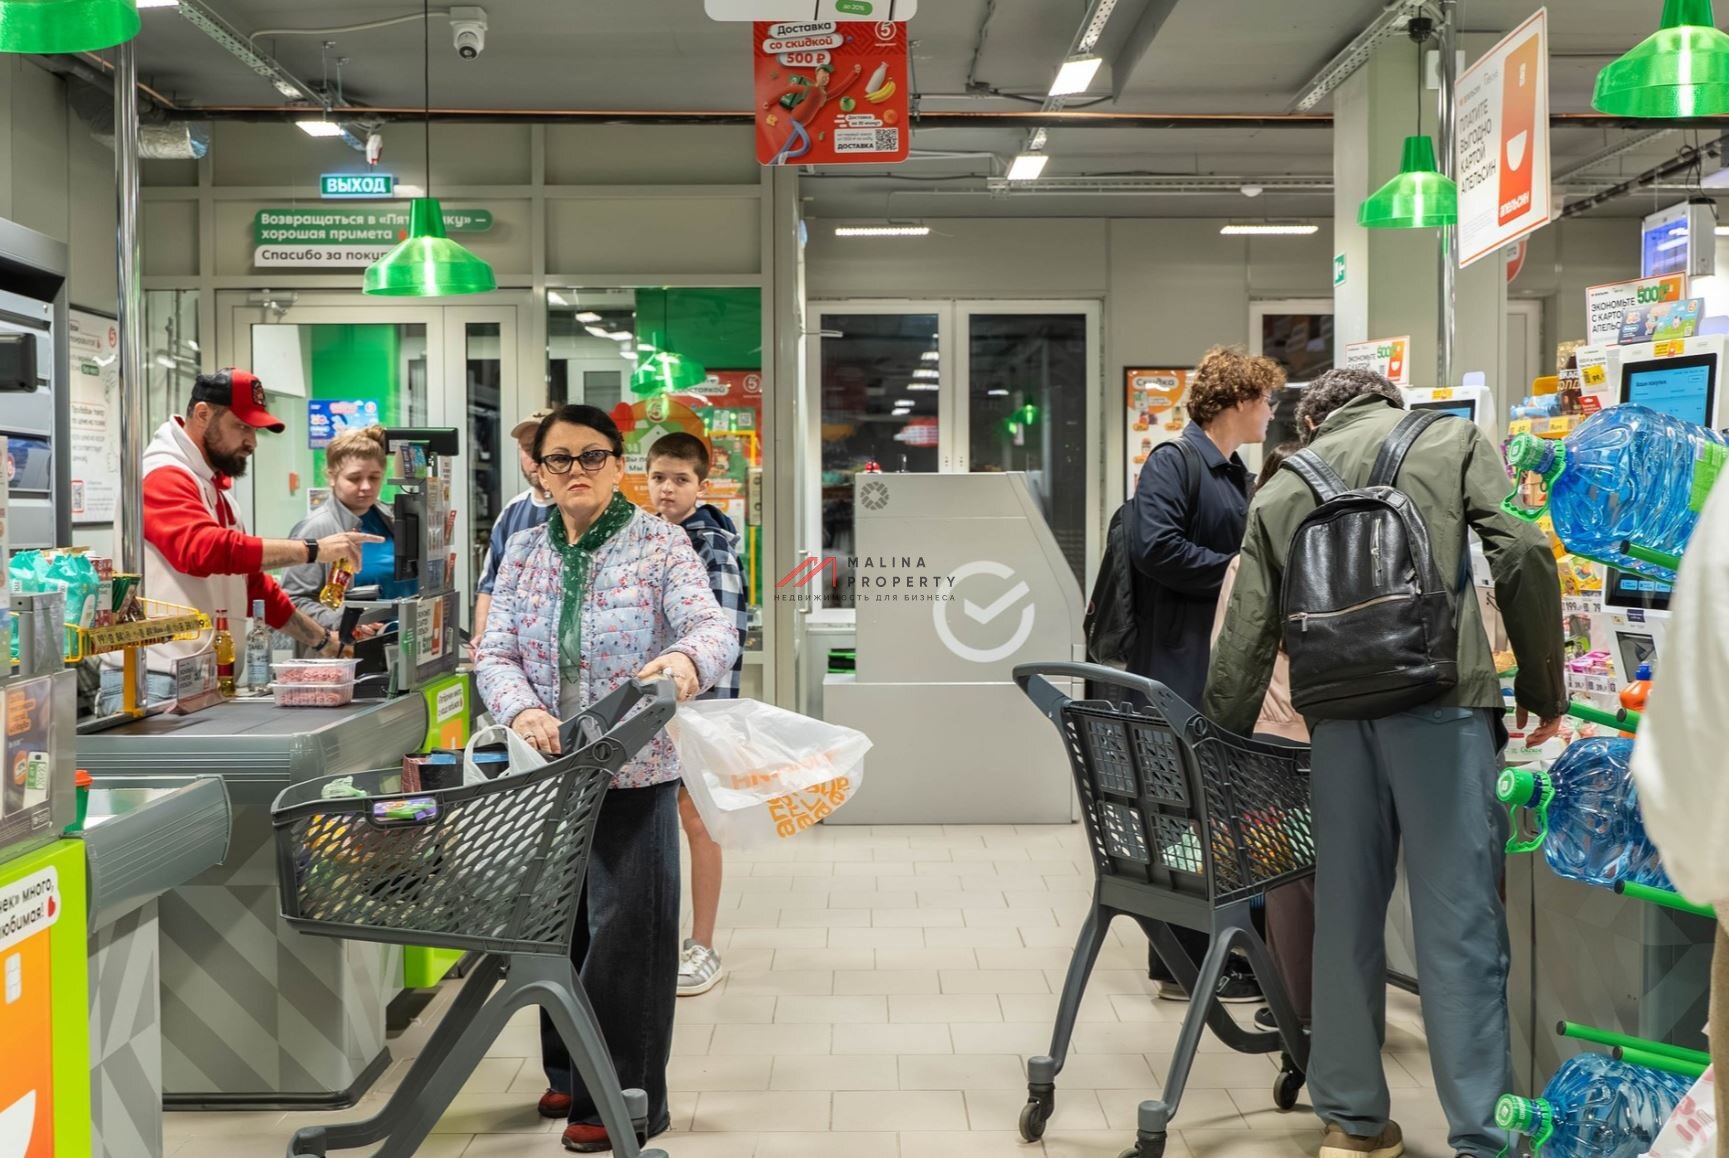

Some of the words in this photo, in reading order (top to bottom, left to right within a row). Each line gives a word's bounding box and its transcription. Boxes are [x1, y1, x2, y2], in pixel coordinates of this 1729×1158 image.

[777, 22, 831, 36] Доставка
[785, 37, 833, 48] скидкой
[787, 53, 813, 63] 500
[1459, 98, 1488, 133] ПЛАТИТЕ
[1460, 118, 1492, 154] ВЫГОДНО
[1460, 141, 1487, 173] КАРТОЙ
[1461, 159, 1496, 193] АПЕЛЬСИН
[327, 178, 386, 193] ВЫХОД
[261, 214, 364, 226] Возвращаться
[368, 216, 376, 225] в
[261, 229, 326, 241] хорошая
[330, 229, 392, 241] примета
[262, 250, 322, 260] Спасибо
[327, 252, 341, 260] за
[1591, 297, 1636, 312] ЭКОНОМЬТЕ
[1592, 314, 1598, 322] С
[1599, 309, 1623, 320] КАРТО
[1592, 322, 1620, 333] АПЕЛЬС
[0, 894, 20, 914] ек»
[22, 878, 55, 903] много,
[0, 902, 44, 938] юбимая!
